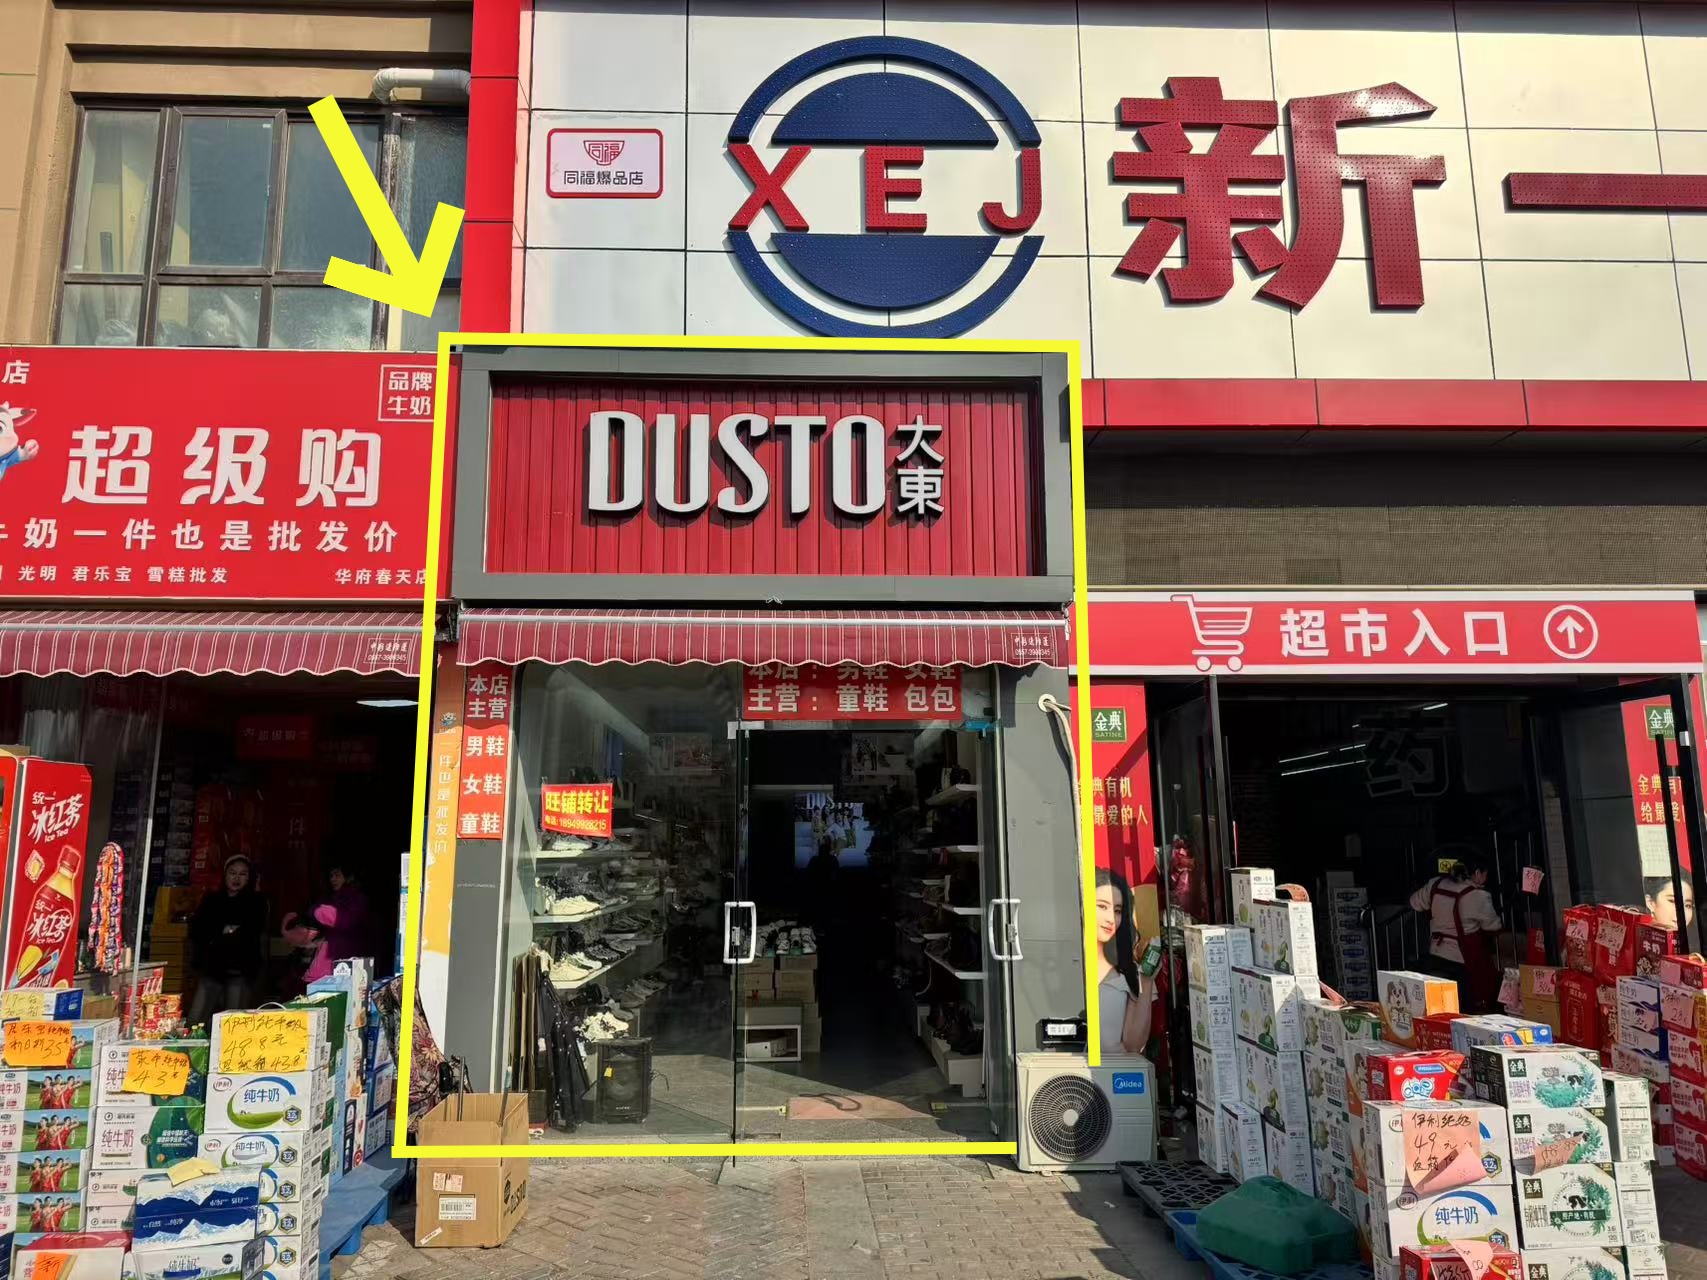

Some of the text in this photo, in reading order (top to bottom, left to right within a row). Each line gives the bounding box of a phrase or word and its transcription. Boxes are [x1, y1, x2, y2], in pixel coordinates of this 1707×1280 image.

[564, 171, 644, 185] 同福爆品店
[728, 143, 1042, 233] XEJ
[389, 371, 433, 391] 品牌
[388, 396, 432, 416] 牛奶
[62, 425, 382, 507] 超级购
[589, 411, 886, 515] DUSTO
[896, 415, 944, 514] 大東
[18, 565, 229, 584] 光明 君乐宝 雪糕批发
[335, 568, 427, 585] 华府春天店
[1280, 608, 1509, 657] 超市入口
[469, 674, 509, 696] 本店
[467, 698, 508, 719] 主营
[836, 685, 889, 712] 童鞋
[904, 685, 957, 713] 包包
[1094, 711, 1122, 732] 金典
[466, 736, 505, 757] 男鞋
[463, 774, 503, 796] 女鞋
[1079, 777, 1132, 799] 典有机
[32, 791, 56, 805] 统一
[545, 790, 609, 814] 旺铺转让
[28, 794, 84, 845] 冰红茶
[460, 812, 501, 835] 童鞋
[1081, 805, 1148, 826] 最爱的人
[27, 909, 74, 943] 冰红茶
[1509, 1061, 1525, 1072] 金典
[1121, 1079, 1142, 1088] Midea
[243, 1088, 280, 1103] 纯牛奶
[1515, 1117, 1530, 1129] 金典
[101, 1129, 134, 1147] 纯牛奶
[235, 1142, 265, 1151] 纯牛奶
[1525, 1181, 1541, 1194] 金典
[1435, 1206, 1479, 1225] 纯牛奶
[1530, 1266, 1546, 1279] 金典
